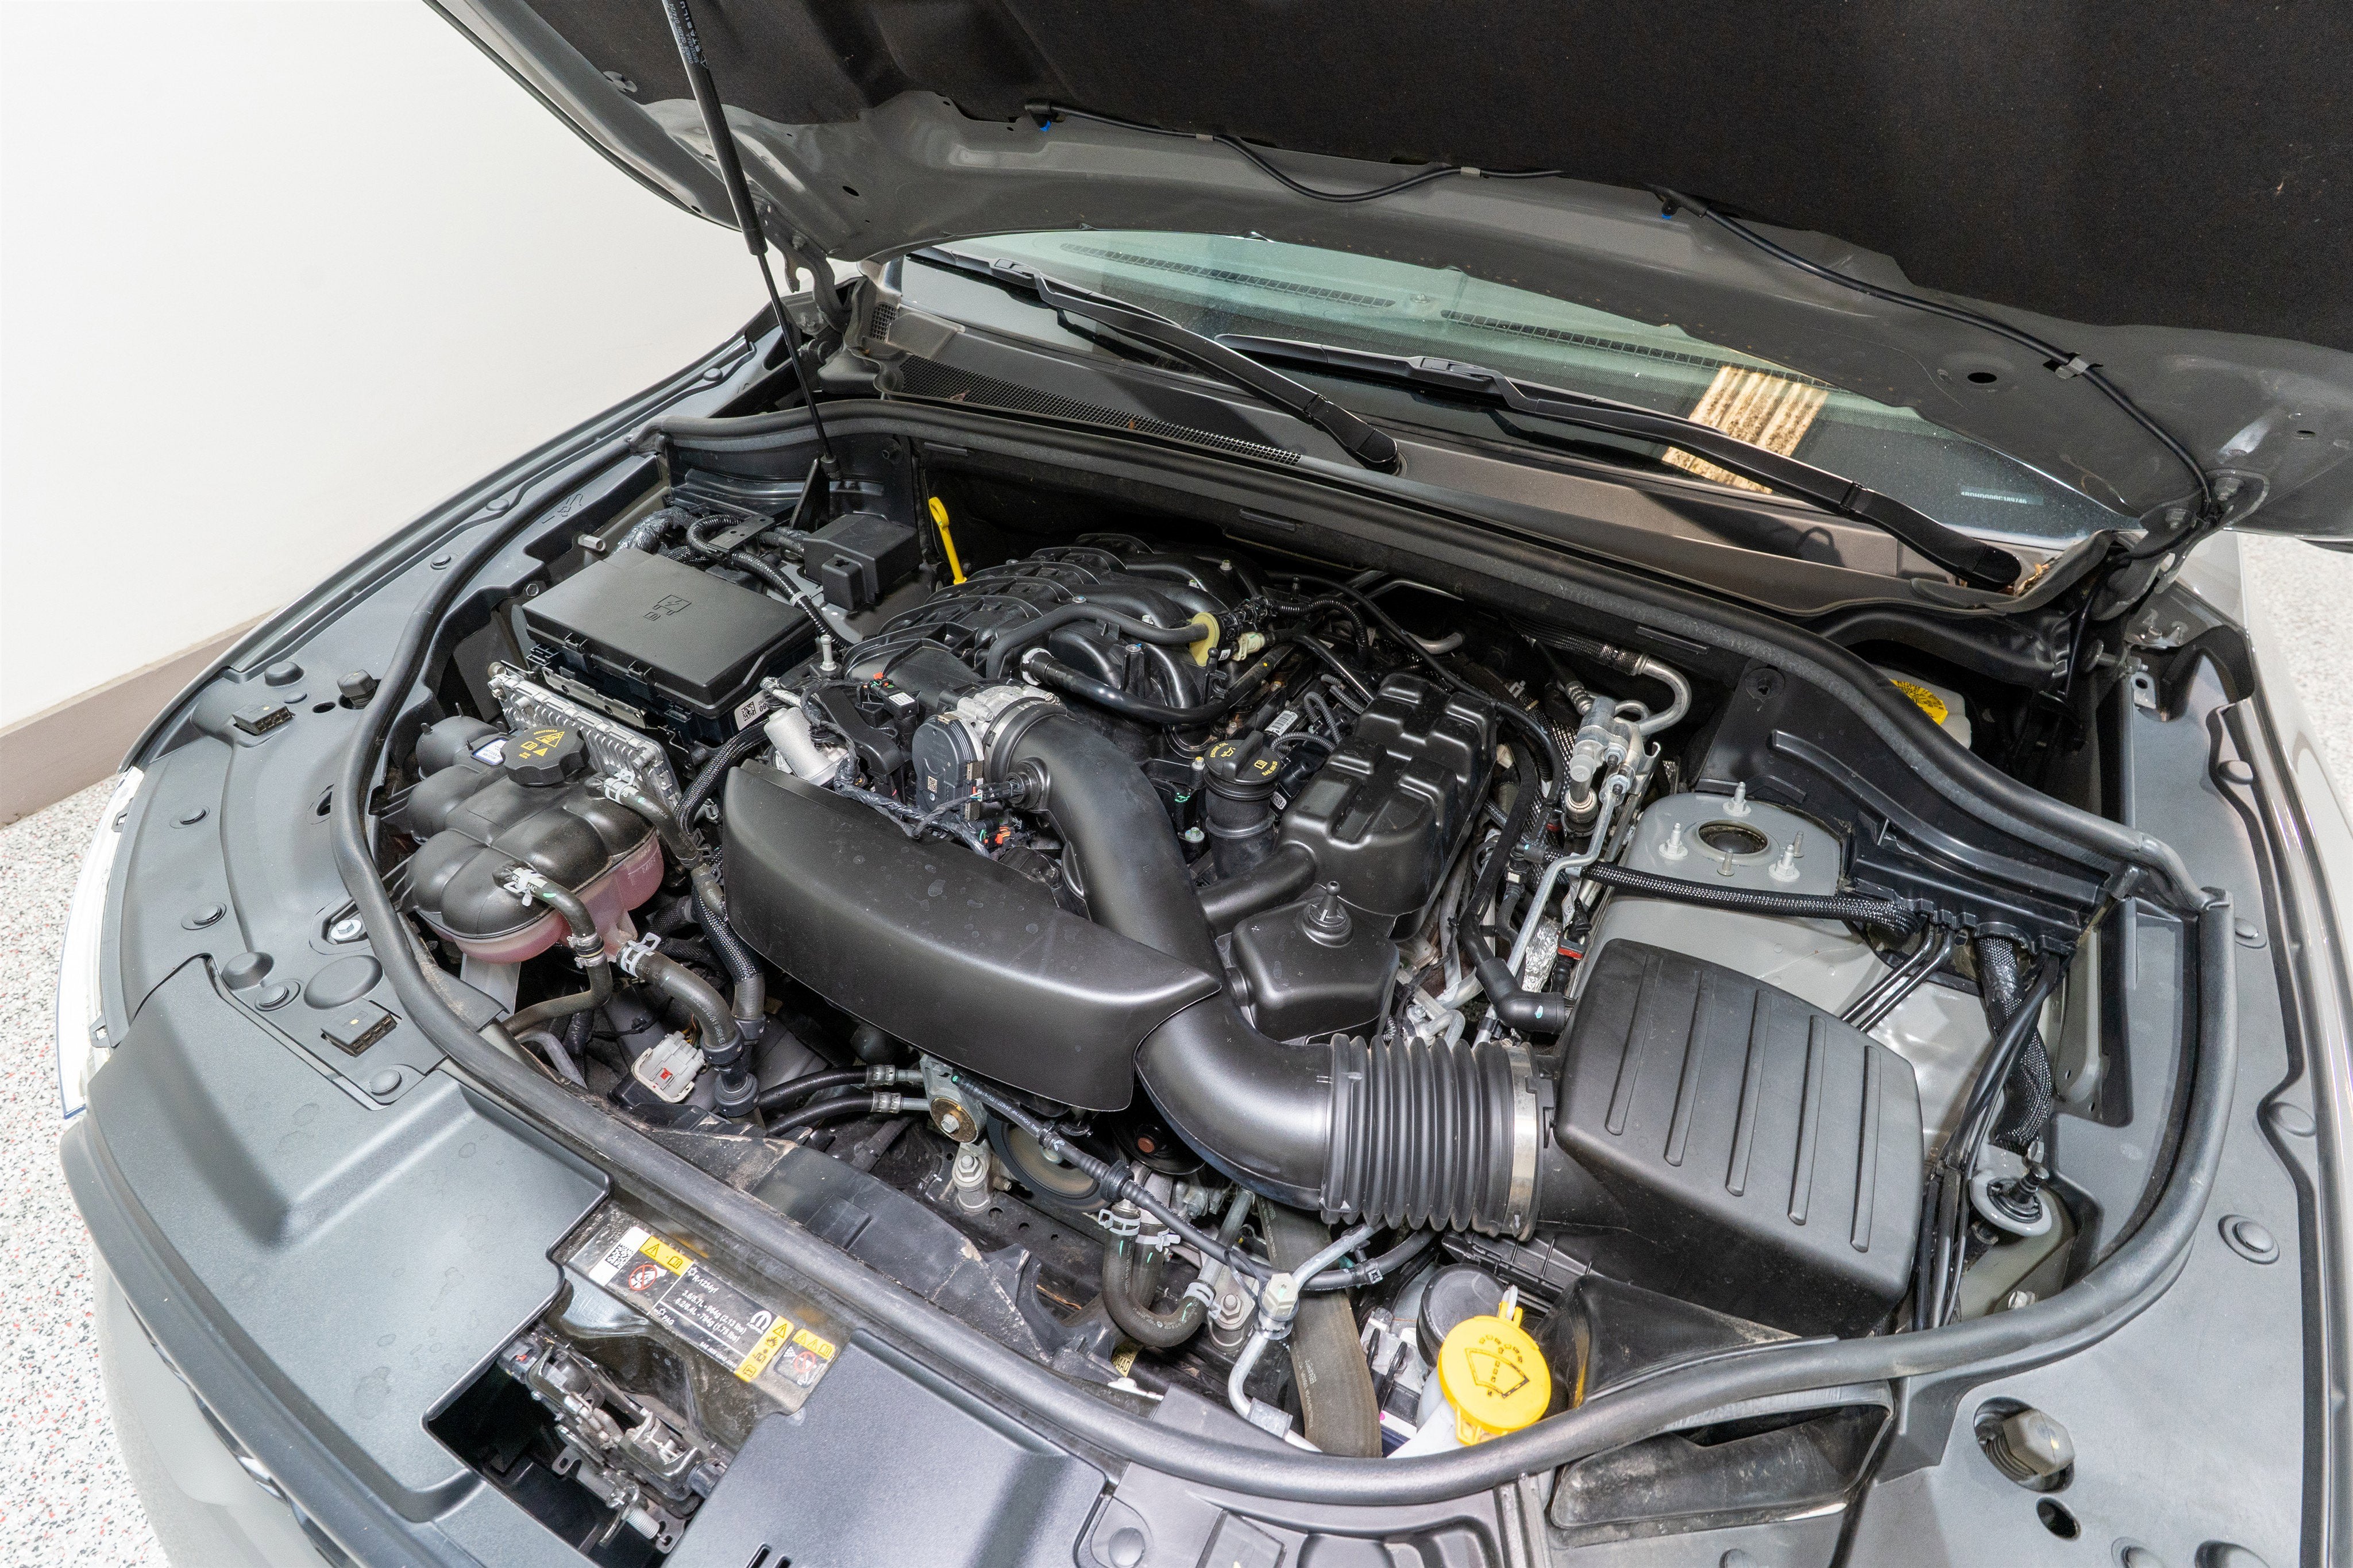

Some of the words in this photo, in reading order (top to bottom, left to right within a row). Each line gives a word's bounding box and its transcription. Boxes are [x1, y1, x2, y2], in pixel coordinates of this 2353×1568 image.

[1210, 745, 1221, 758] ENGINE
[692, 1275, 719, 1293] R-1234yf
[682, 1289, 705, 1308] 3.6/5.7L
[734, 1322, 747, 1335] lbs)
[662, 1315, 675, 1326] PAG
[675, 1298, 699, 1315] 6.2/6.4L
[699, 1313, 715, 1327] 794g
[713, 1322, 730, 1335] (1.75
[727, 1331, 740, 1343] lbs)
[699, 1341, 709, 1350] SAE
